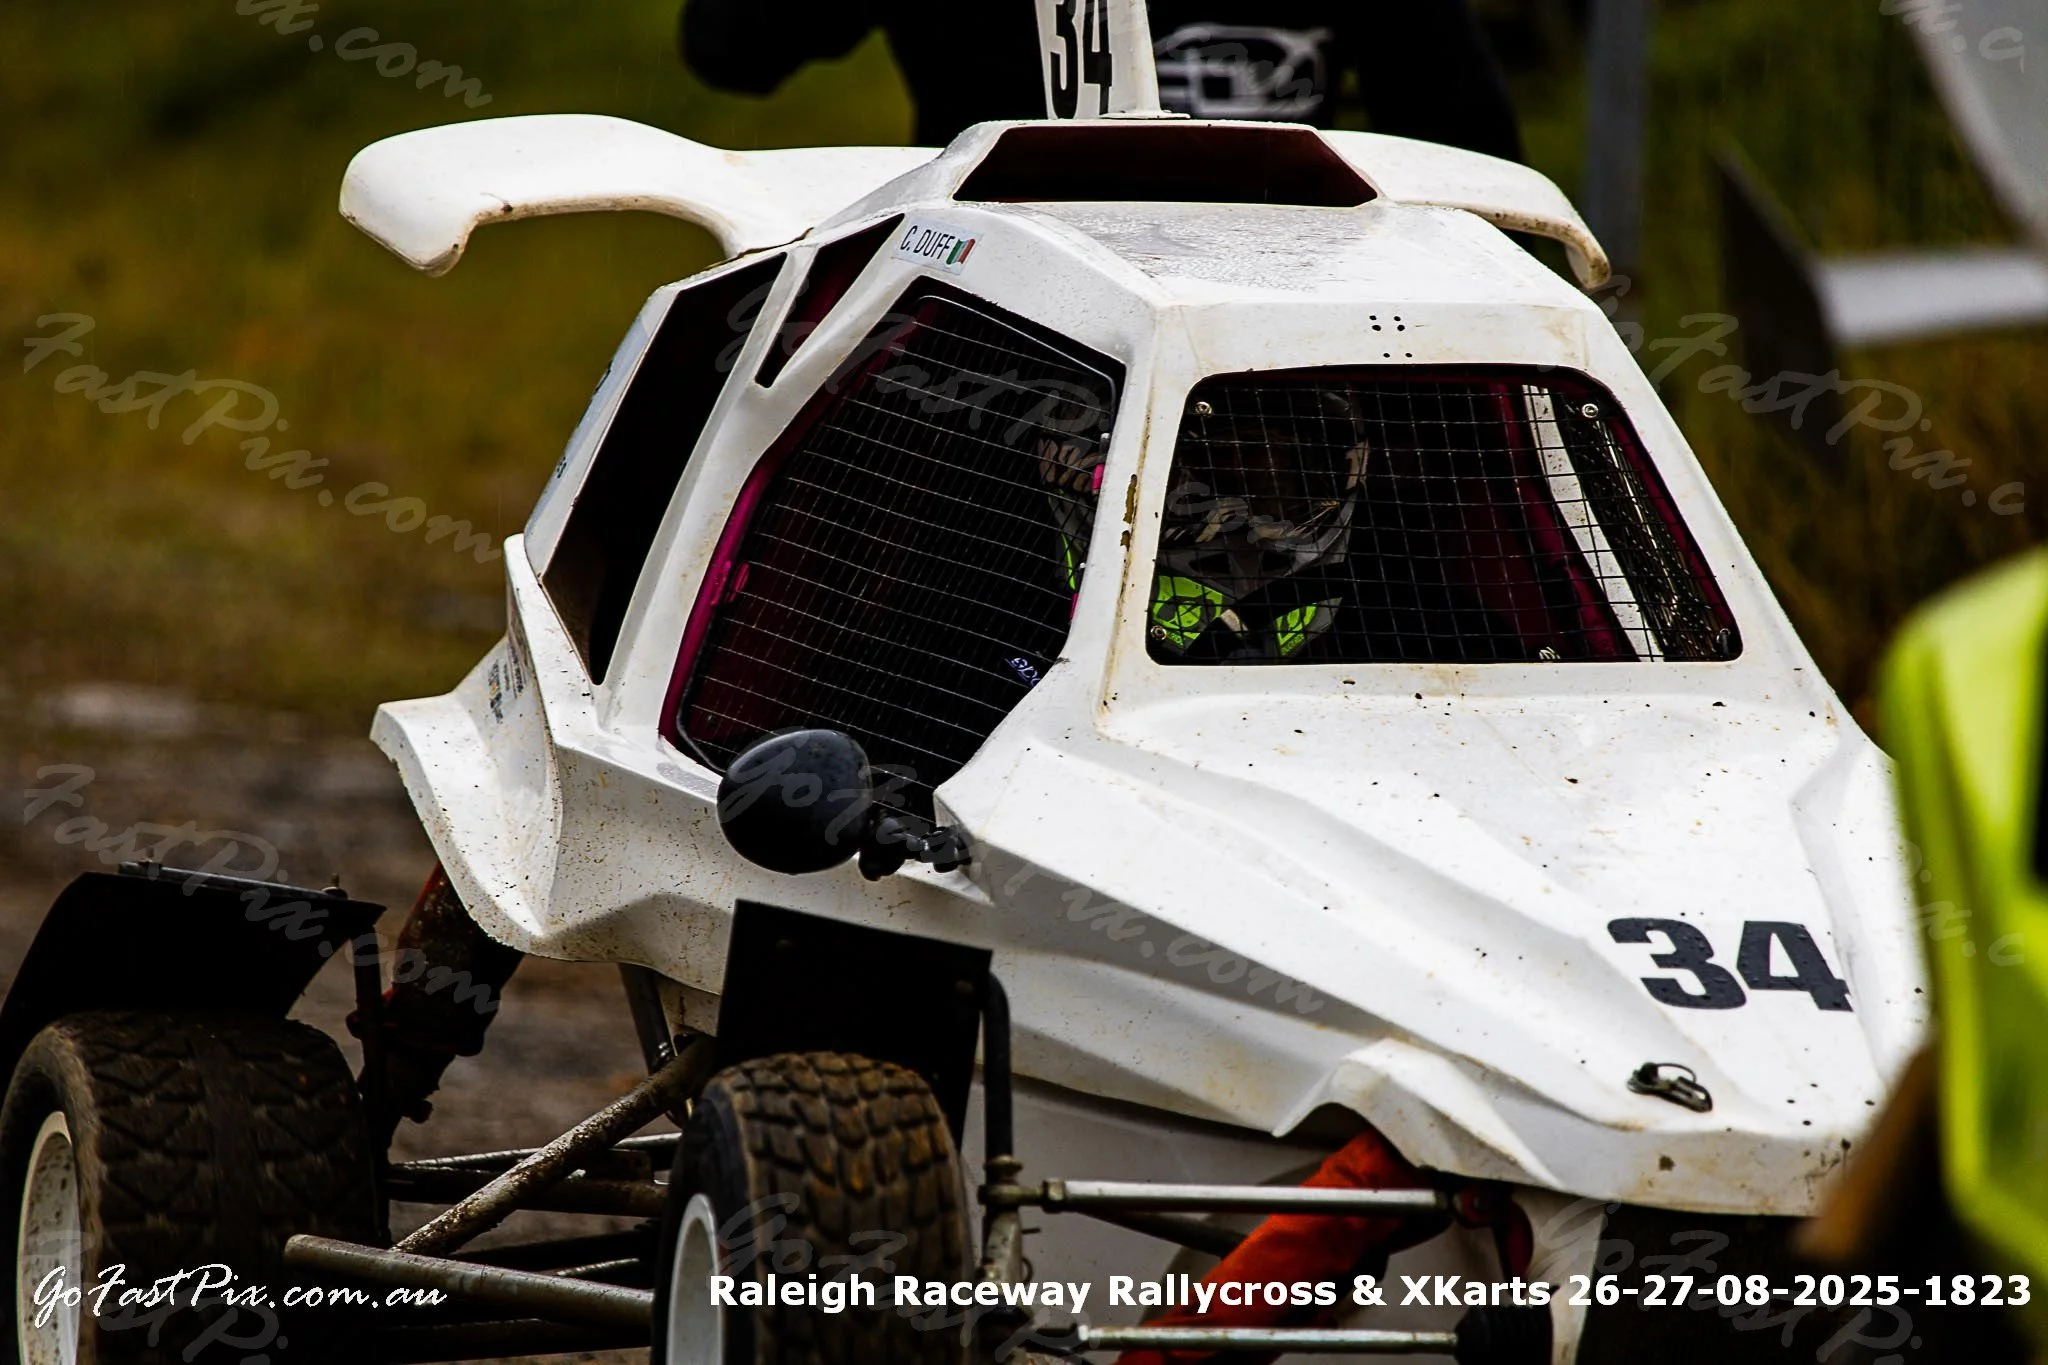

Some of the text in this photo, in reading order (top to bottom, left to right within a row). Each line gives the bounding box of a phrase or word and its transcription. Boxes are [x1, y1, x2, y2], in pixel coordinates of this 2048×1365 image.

[1050, 0, 1112, 119] 34
[900, 225, 956, 260] C. DUFF
[1608, 918, 1853, 1011] 34
